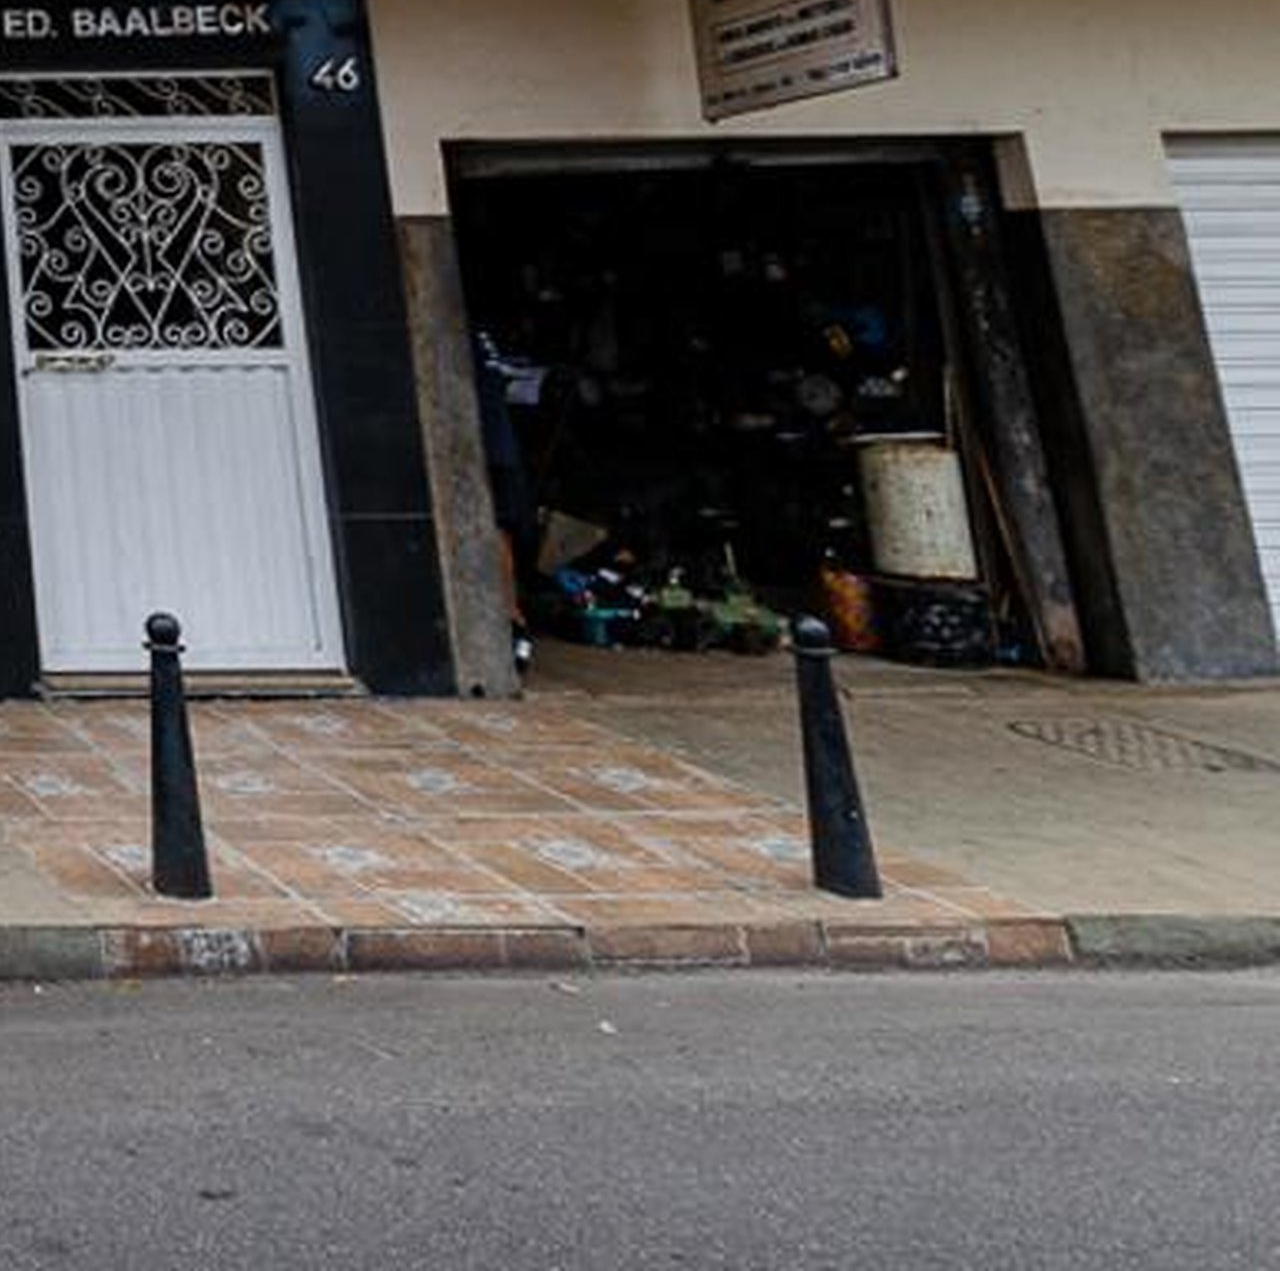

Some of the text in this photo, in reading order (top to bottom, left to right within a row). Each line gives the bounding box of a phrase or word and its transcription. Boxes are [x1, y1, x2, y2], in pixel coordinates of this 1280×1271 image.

[2, 3, 271, 38] ED. BAALBECK
[312, 57, 358, 90] 46
